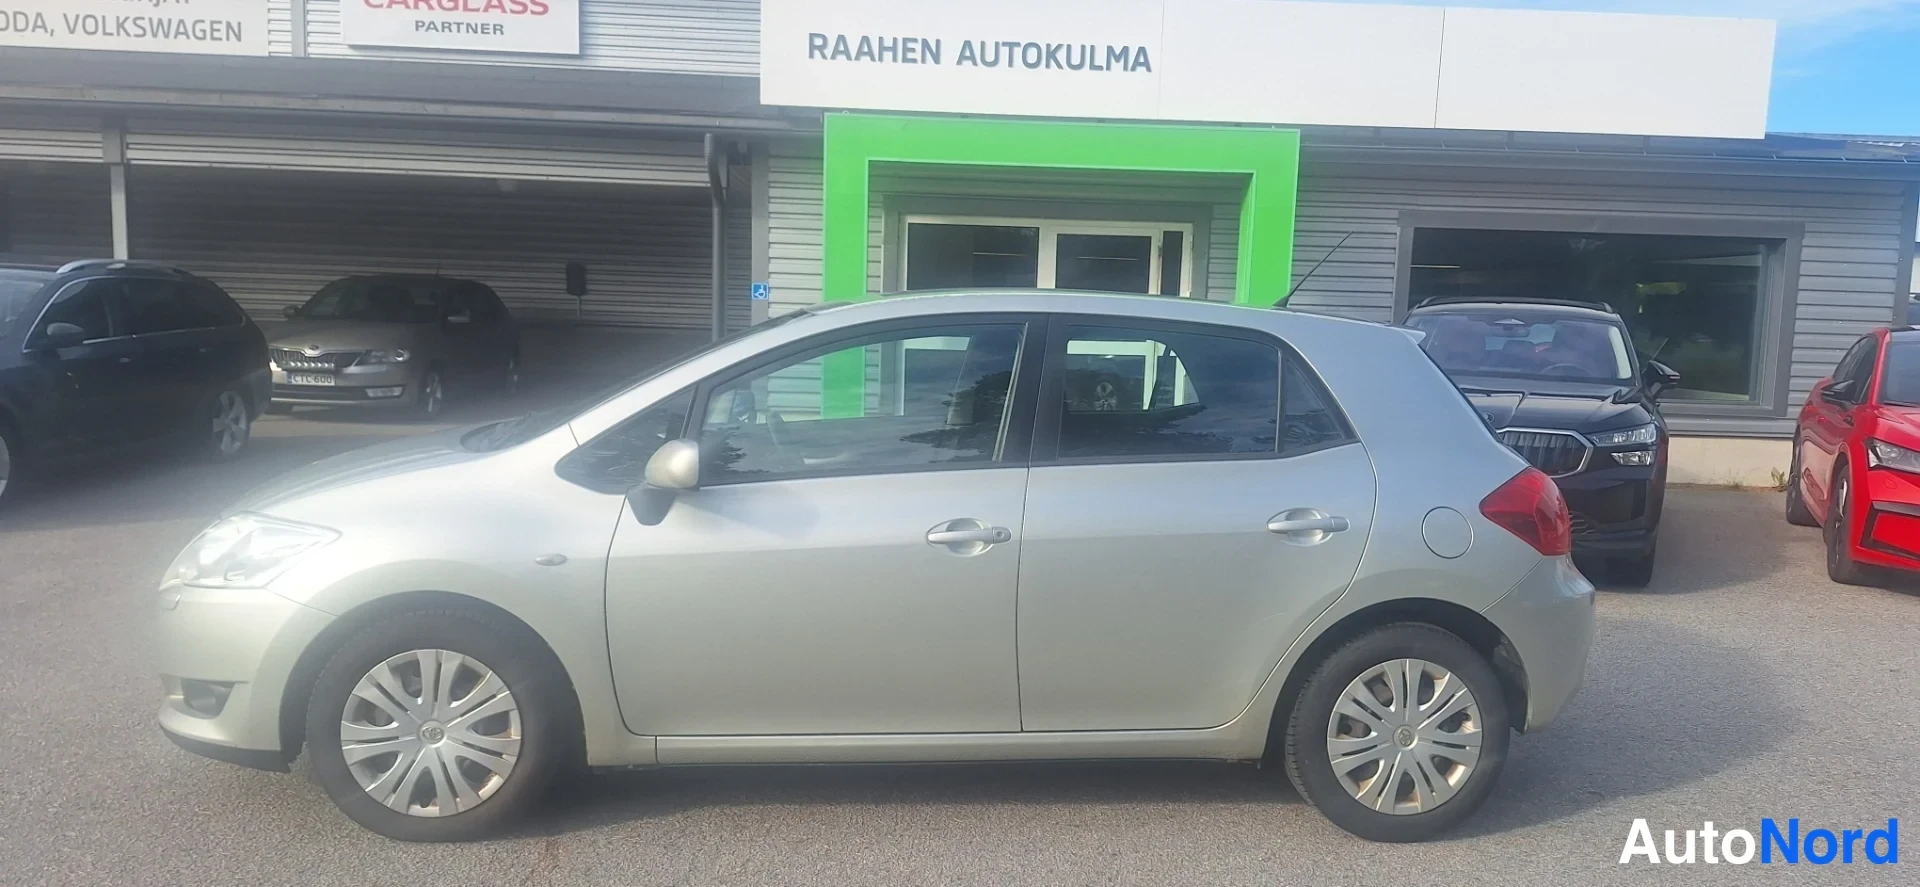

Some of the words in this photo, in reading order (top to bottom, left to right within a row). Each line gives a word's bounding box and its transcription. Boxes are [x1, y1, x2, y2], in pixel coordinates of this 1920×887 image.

[62, 12, 242, 42] VOLKSWAGEN
[414, 20, 505, 36] PARTNER
[807, 32, 943, 64] RAAHEN
[956, 39, 1153, 73] AUTOKULMA
